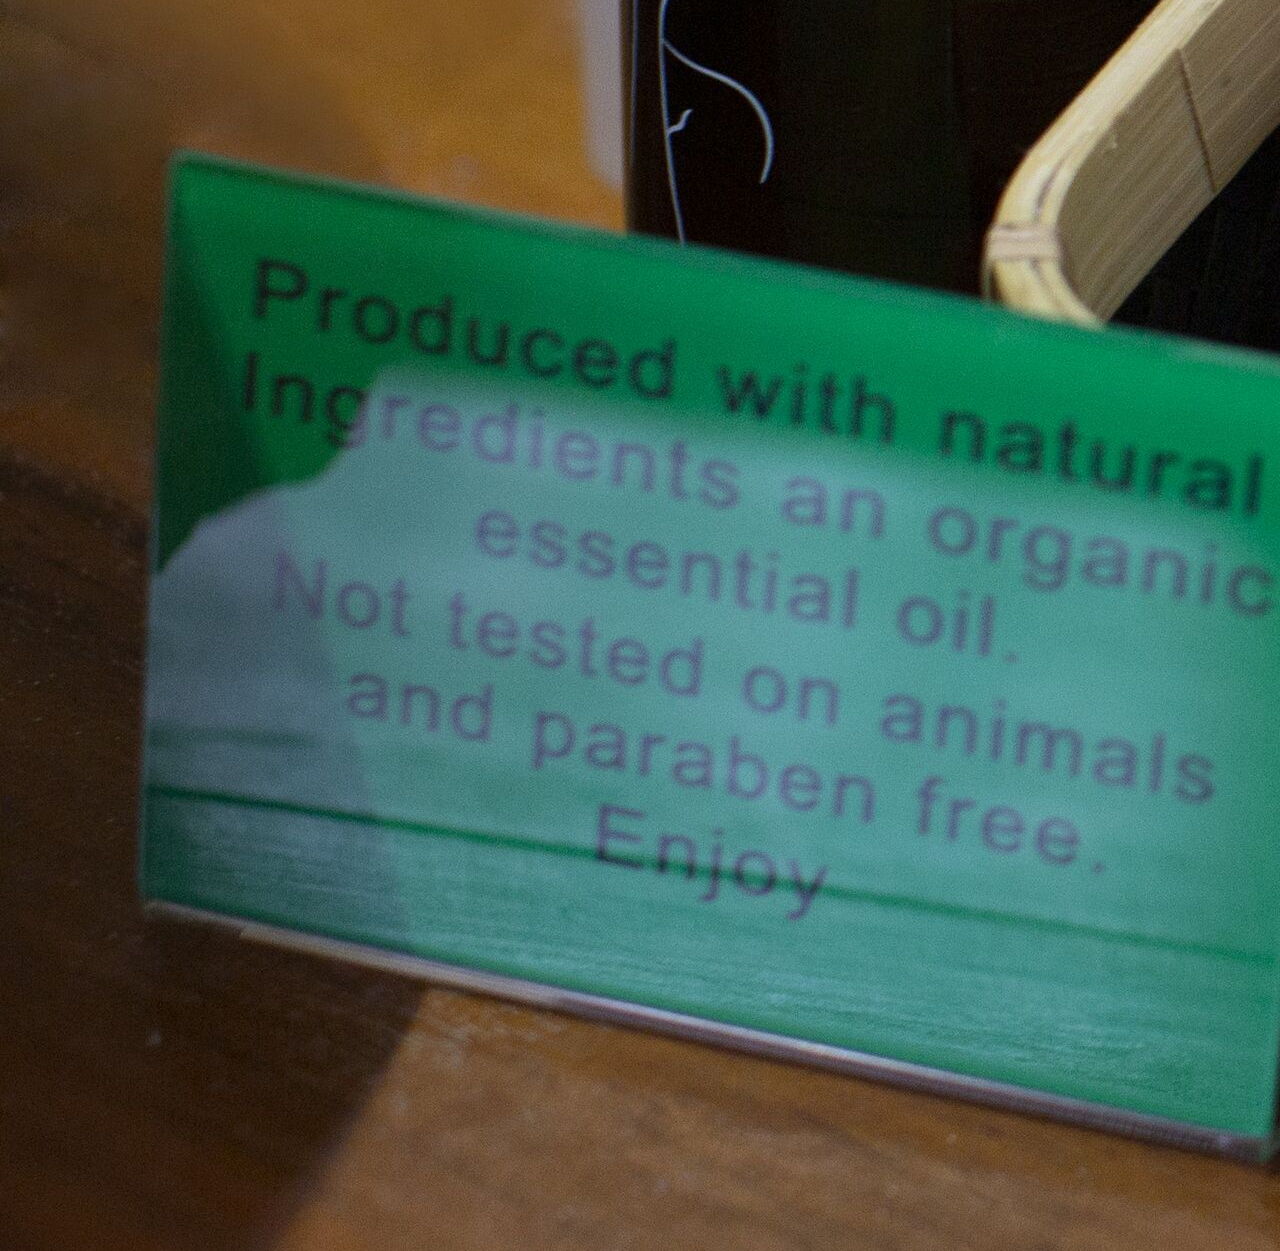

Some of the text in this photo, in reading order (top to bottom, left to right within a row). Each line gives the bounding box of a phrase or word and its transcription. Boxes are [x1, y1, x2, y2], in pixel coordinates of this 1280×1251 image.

[242, 350, 1276, 618] Ingredients an organic
[252, 256, 1265, 517] Produced with natural
[272, 551, 1216, 805] Not tested on animals
[474, 508, 1020, 665] essential oil.
[346, 670, 1105, 875] and paraben free.
[596, 803, 829, 921] Enjoy
